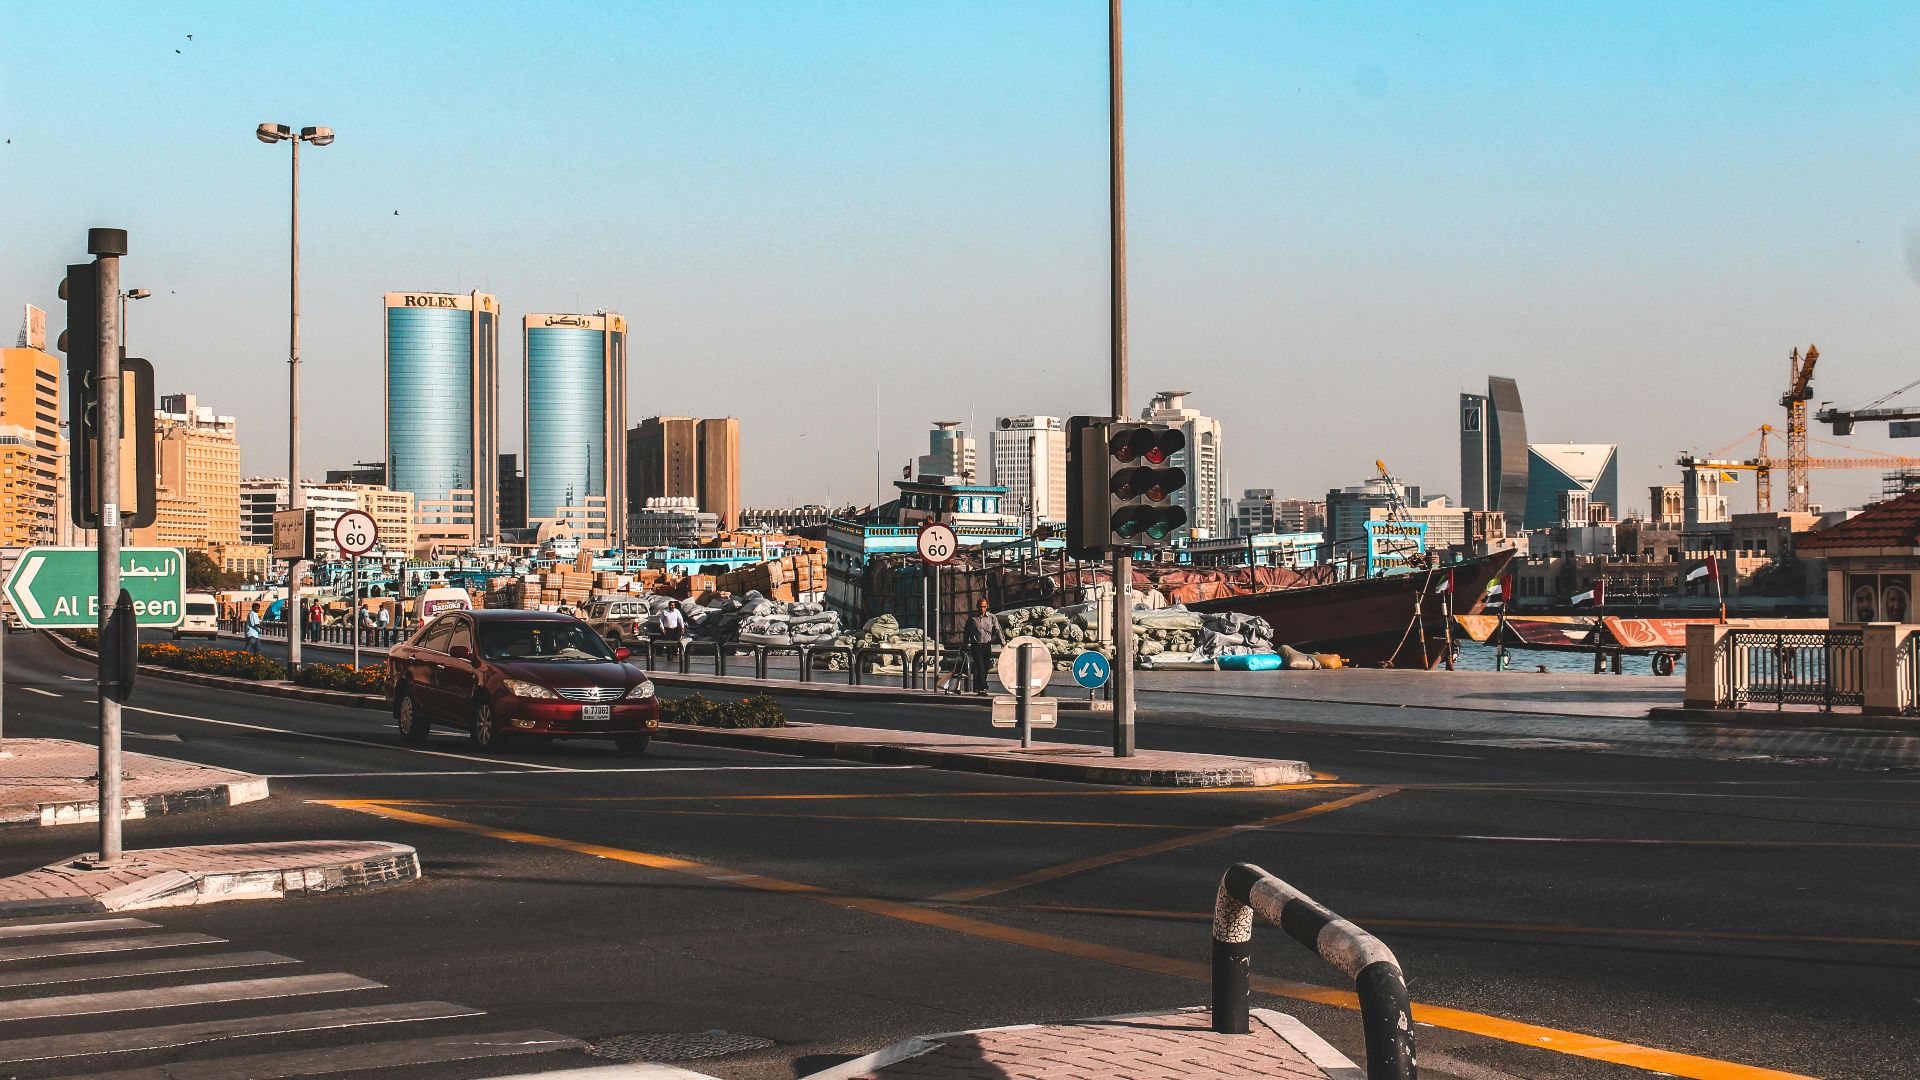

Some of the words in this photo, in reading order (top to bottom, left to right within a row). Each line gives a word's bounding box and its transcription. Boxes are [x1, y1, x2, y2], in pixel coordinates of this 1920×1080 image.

[404, 295, 458, 308] ROLEX
[345, 533, 366, 545] 60
[928, 544, 947, 556] 60
[119, 557, 176, 582] البطي
[53, 596, 80, 616] Al
[433, 602, 460, 611] Bazooka
